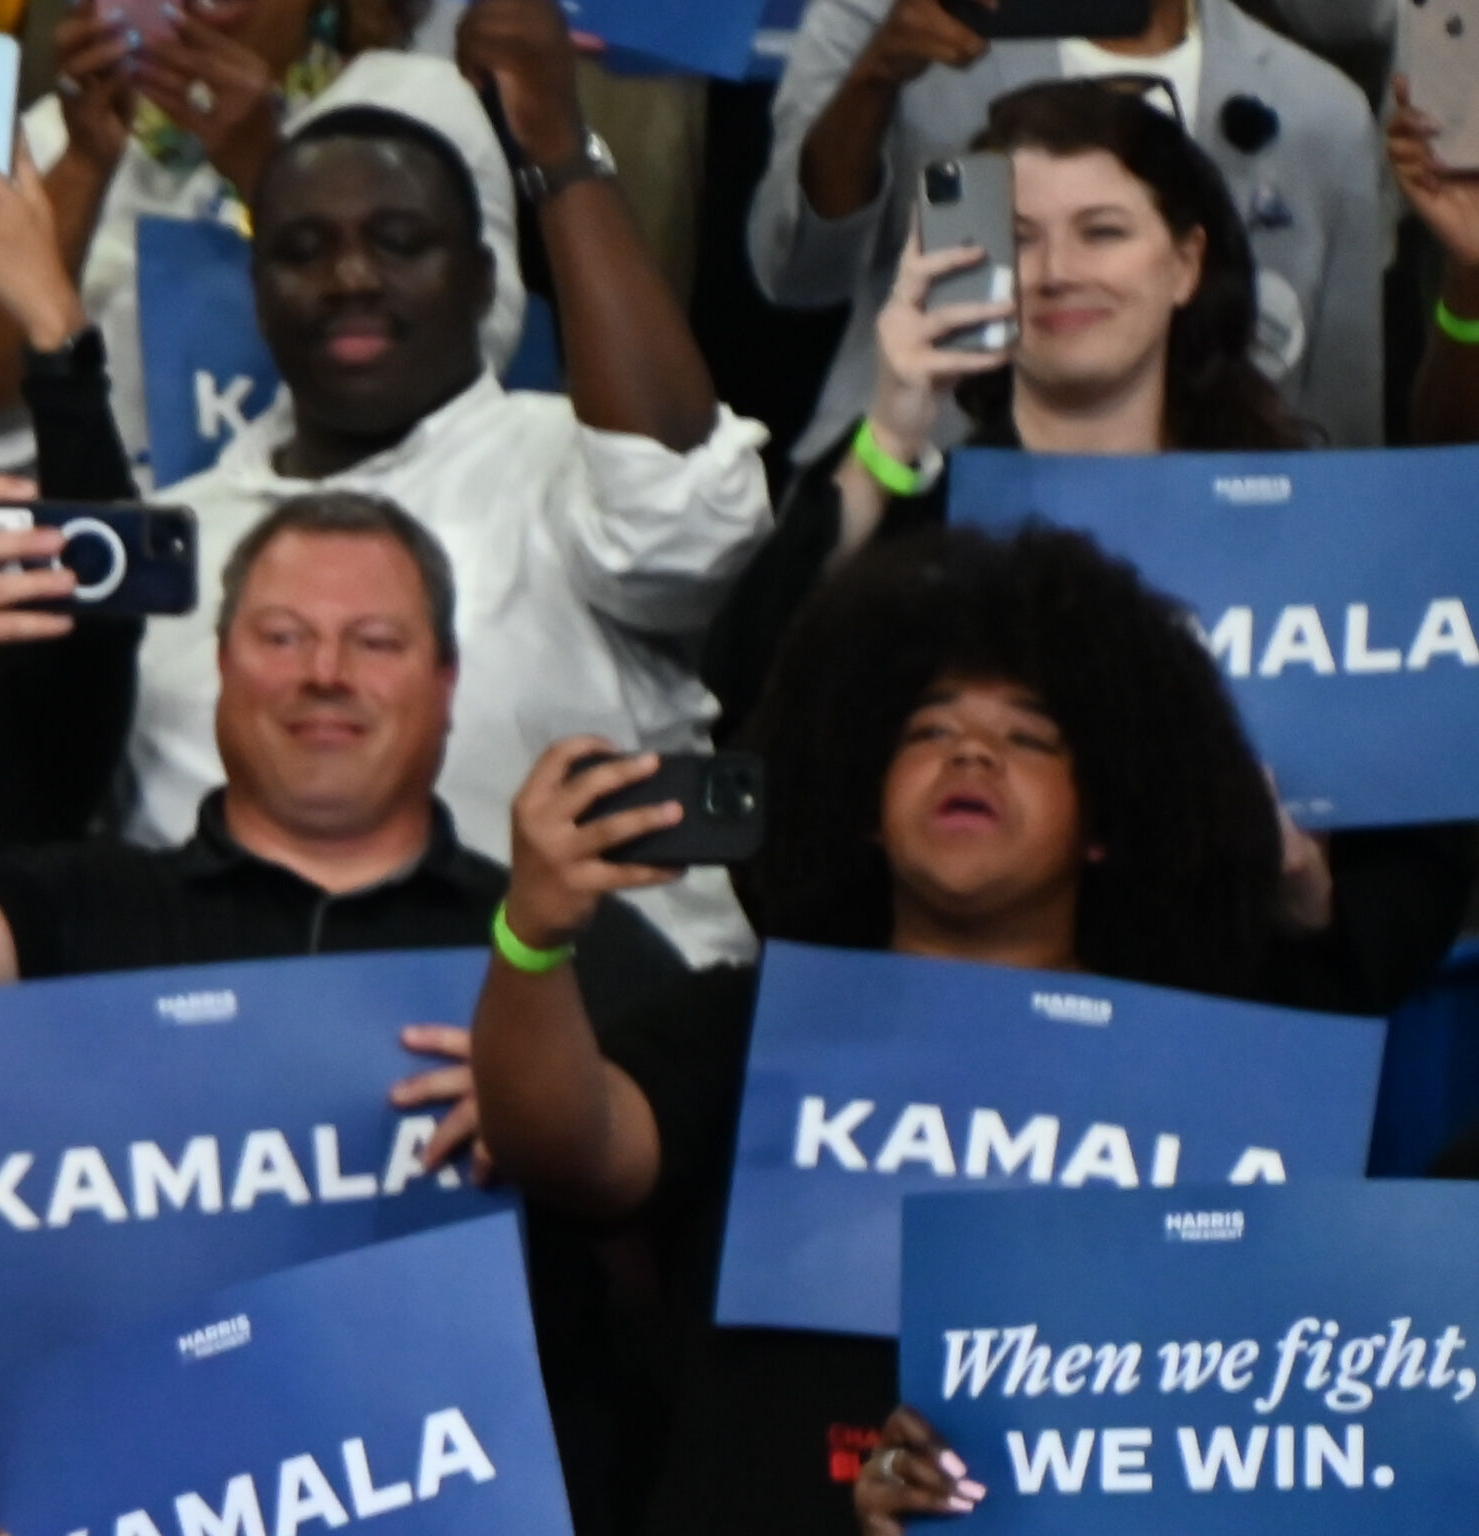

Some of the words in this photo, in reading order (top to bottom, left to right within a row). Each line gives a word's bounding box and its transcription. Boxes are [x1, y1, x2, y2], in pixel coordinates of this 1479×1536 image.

[1166, 1211, 1244, 1230] HARRIS
[943, 1323, 1143, 1399] When
[1158, 1339, 1260, 1393] we
[1255, 1316, 1479, 1414] fight,
[1006, 1427, 1153, 1494] WE
[1176, 1423, 1396, 1492] WIN.
